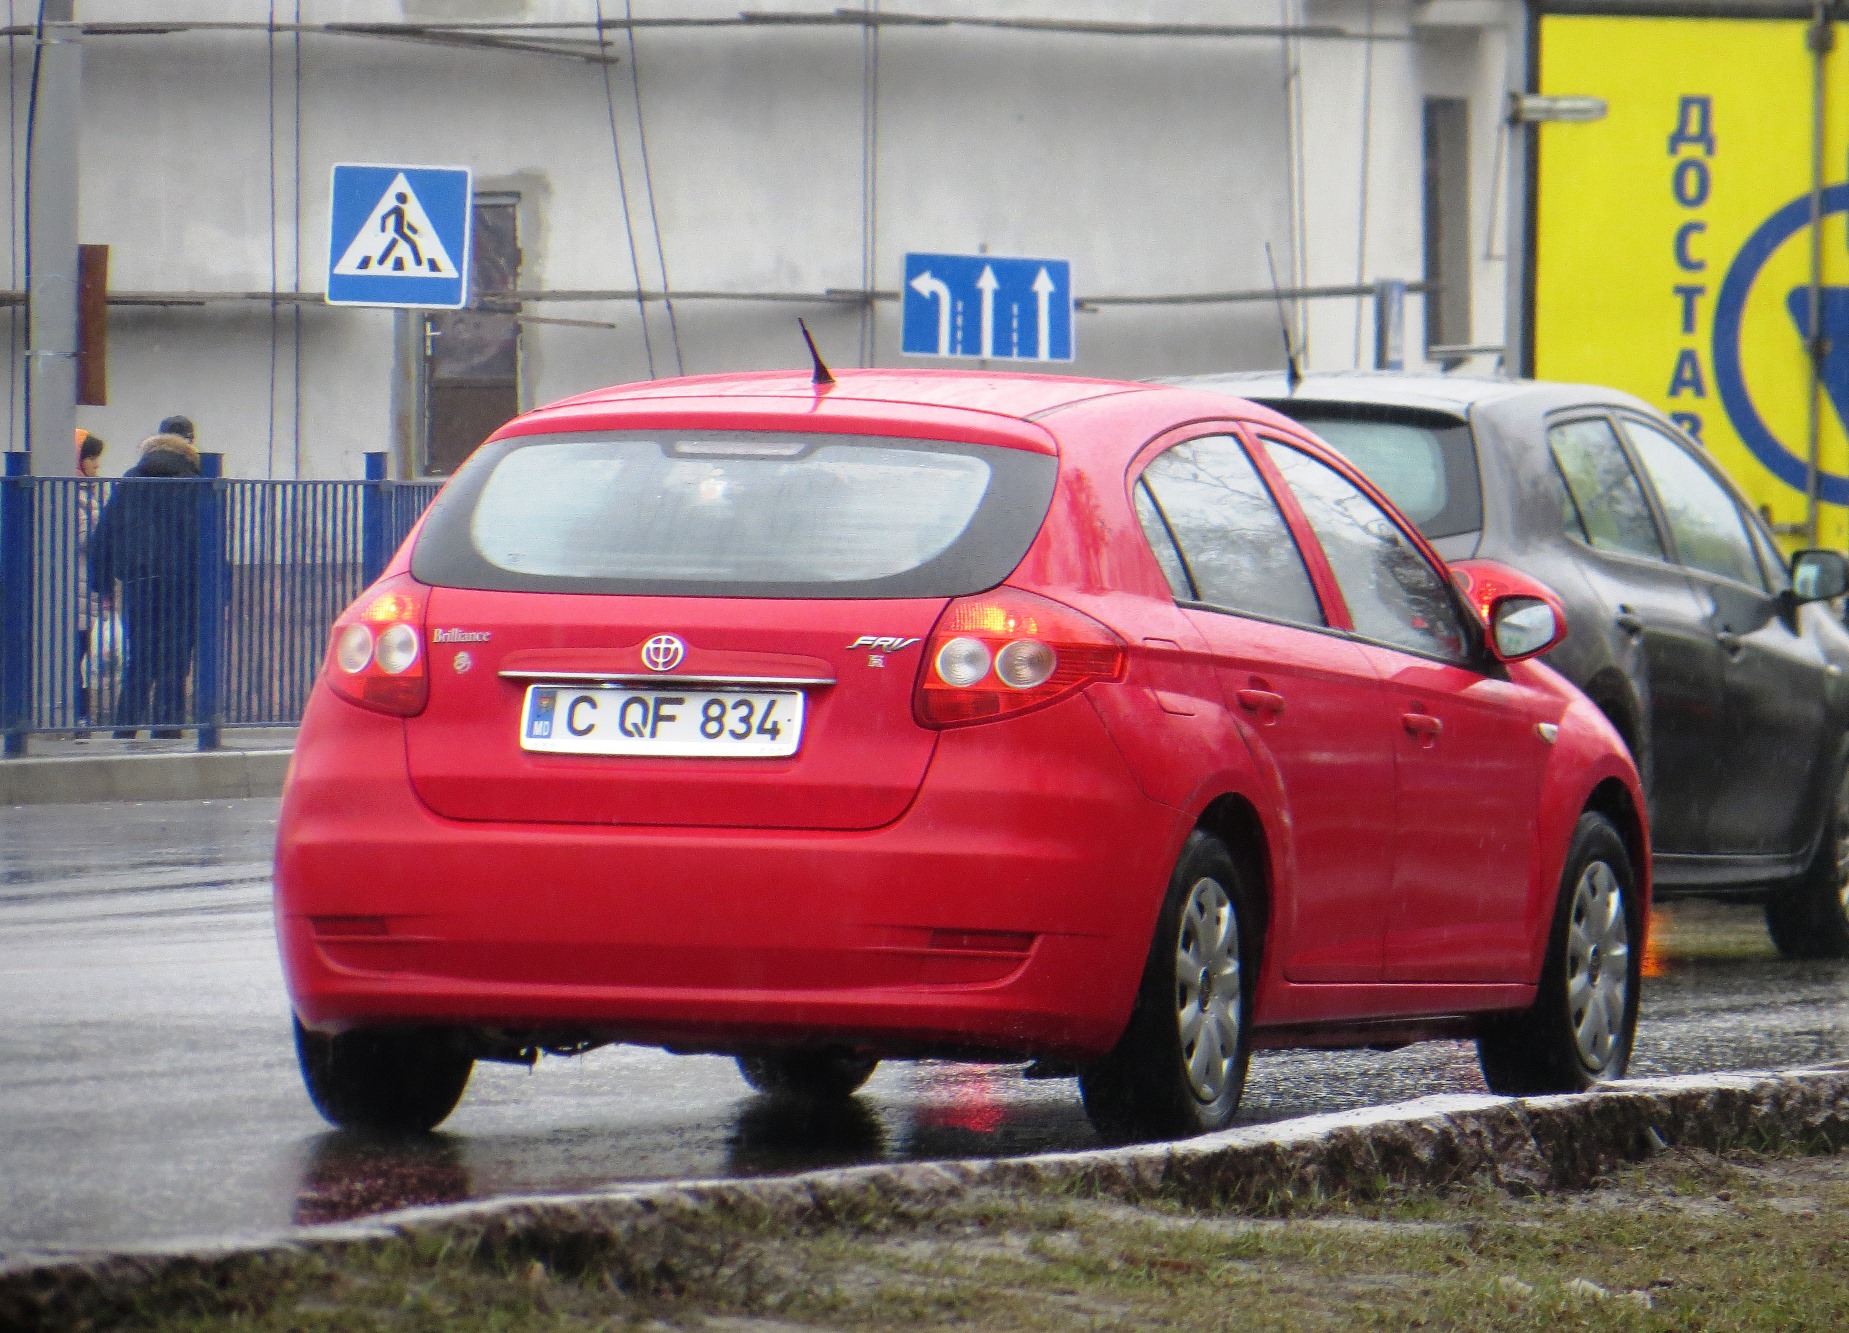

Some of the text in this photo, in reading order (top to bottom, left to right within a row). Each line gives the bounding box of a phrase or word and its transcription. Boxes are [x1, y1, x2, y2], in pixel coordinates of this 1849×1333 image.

[432, 628, 491, 643] Brilliance
[845, 636, 921, 653] FRV
[566, 695, 782, 741] C QF 834
[532, 720, 551, 736] MD
